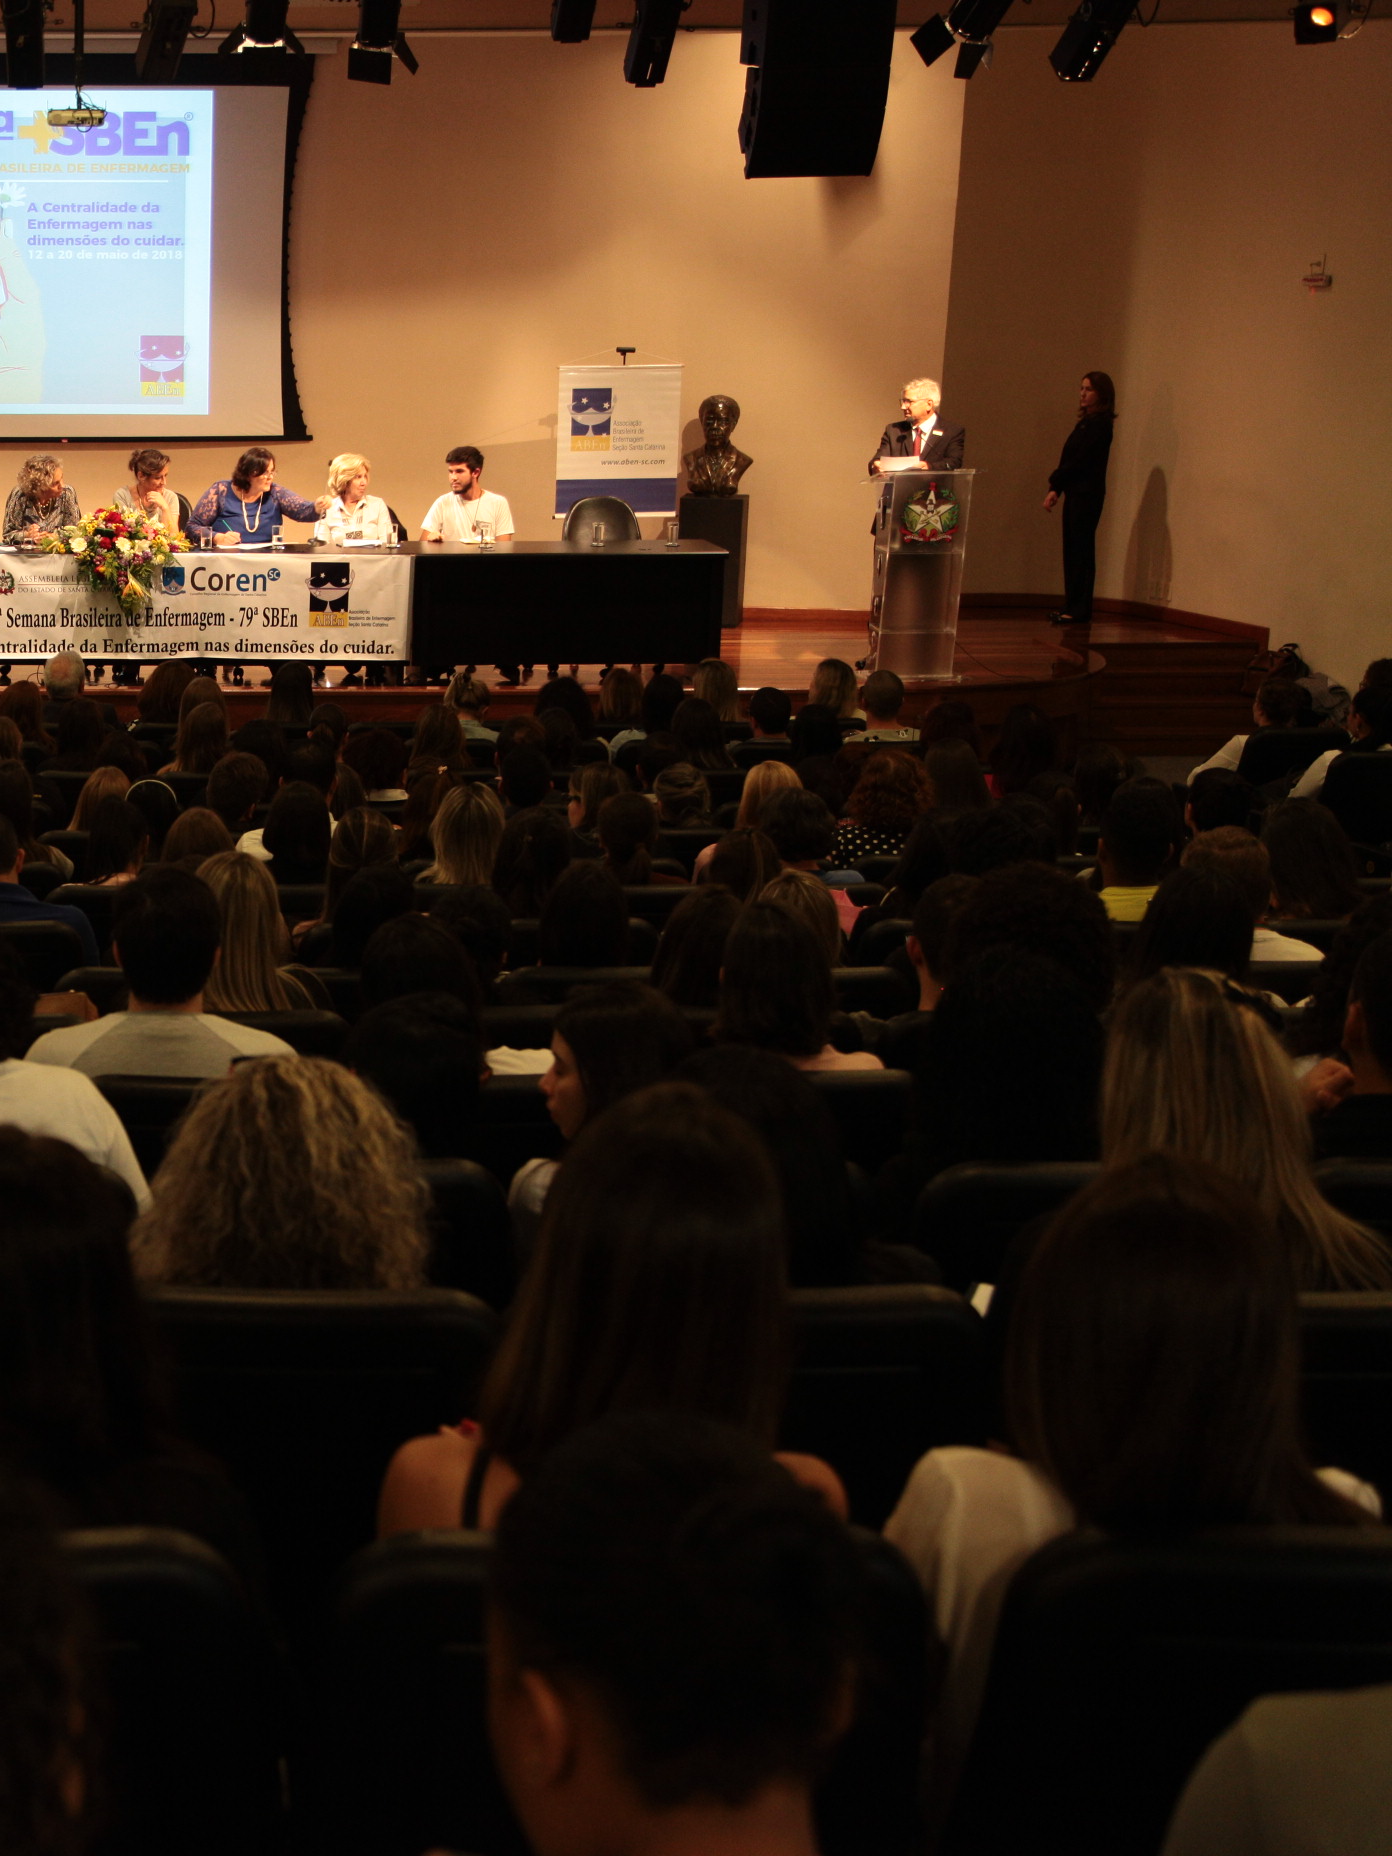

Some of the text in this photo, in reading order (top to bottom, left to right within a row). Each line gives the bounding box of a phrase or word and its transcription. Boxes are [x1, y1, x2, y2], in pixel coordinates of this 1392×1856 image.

[67, 163, 86, 174] DE
[91, 163, 190, 174] ENFERMAGEM
[27, 201, 160, 213] A Centralidade da
[27, 218, 153, 232] Enfermagem nas
[27, 234, 185, 246] dimensões do cuidar.
[28, 249, 183, 260] 12 a 20 de maio de 2018
[18, 575, 69, 583] ASSEMBLEIA
[190, 566, 279, 592] Coren SC
[7, 607, 56, 628] Semana
[60, 607, 122, 628] Brasileira
[125, 608, 141, 628] de
[145, 606, 225, 631] Enfermagem
[239, 606, 259, 628] 79ª
[262, 606, 298, 628] SBEn
[313, 613, 345, 627] ABEn
[80, 638, 97, 653] da
[102, 638, 200, 656] Enfermagem
[205, 640, 230, 653] nas
[234, 638, 315, 654] dimensões
[319, 639, 338, 654] do
[343, 640, 395, 655] cuidar.
